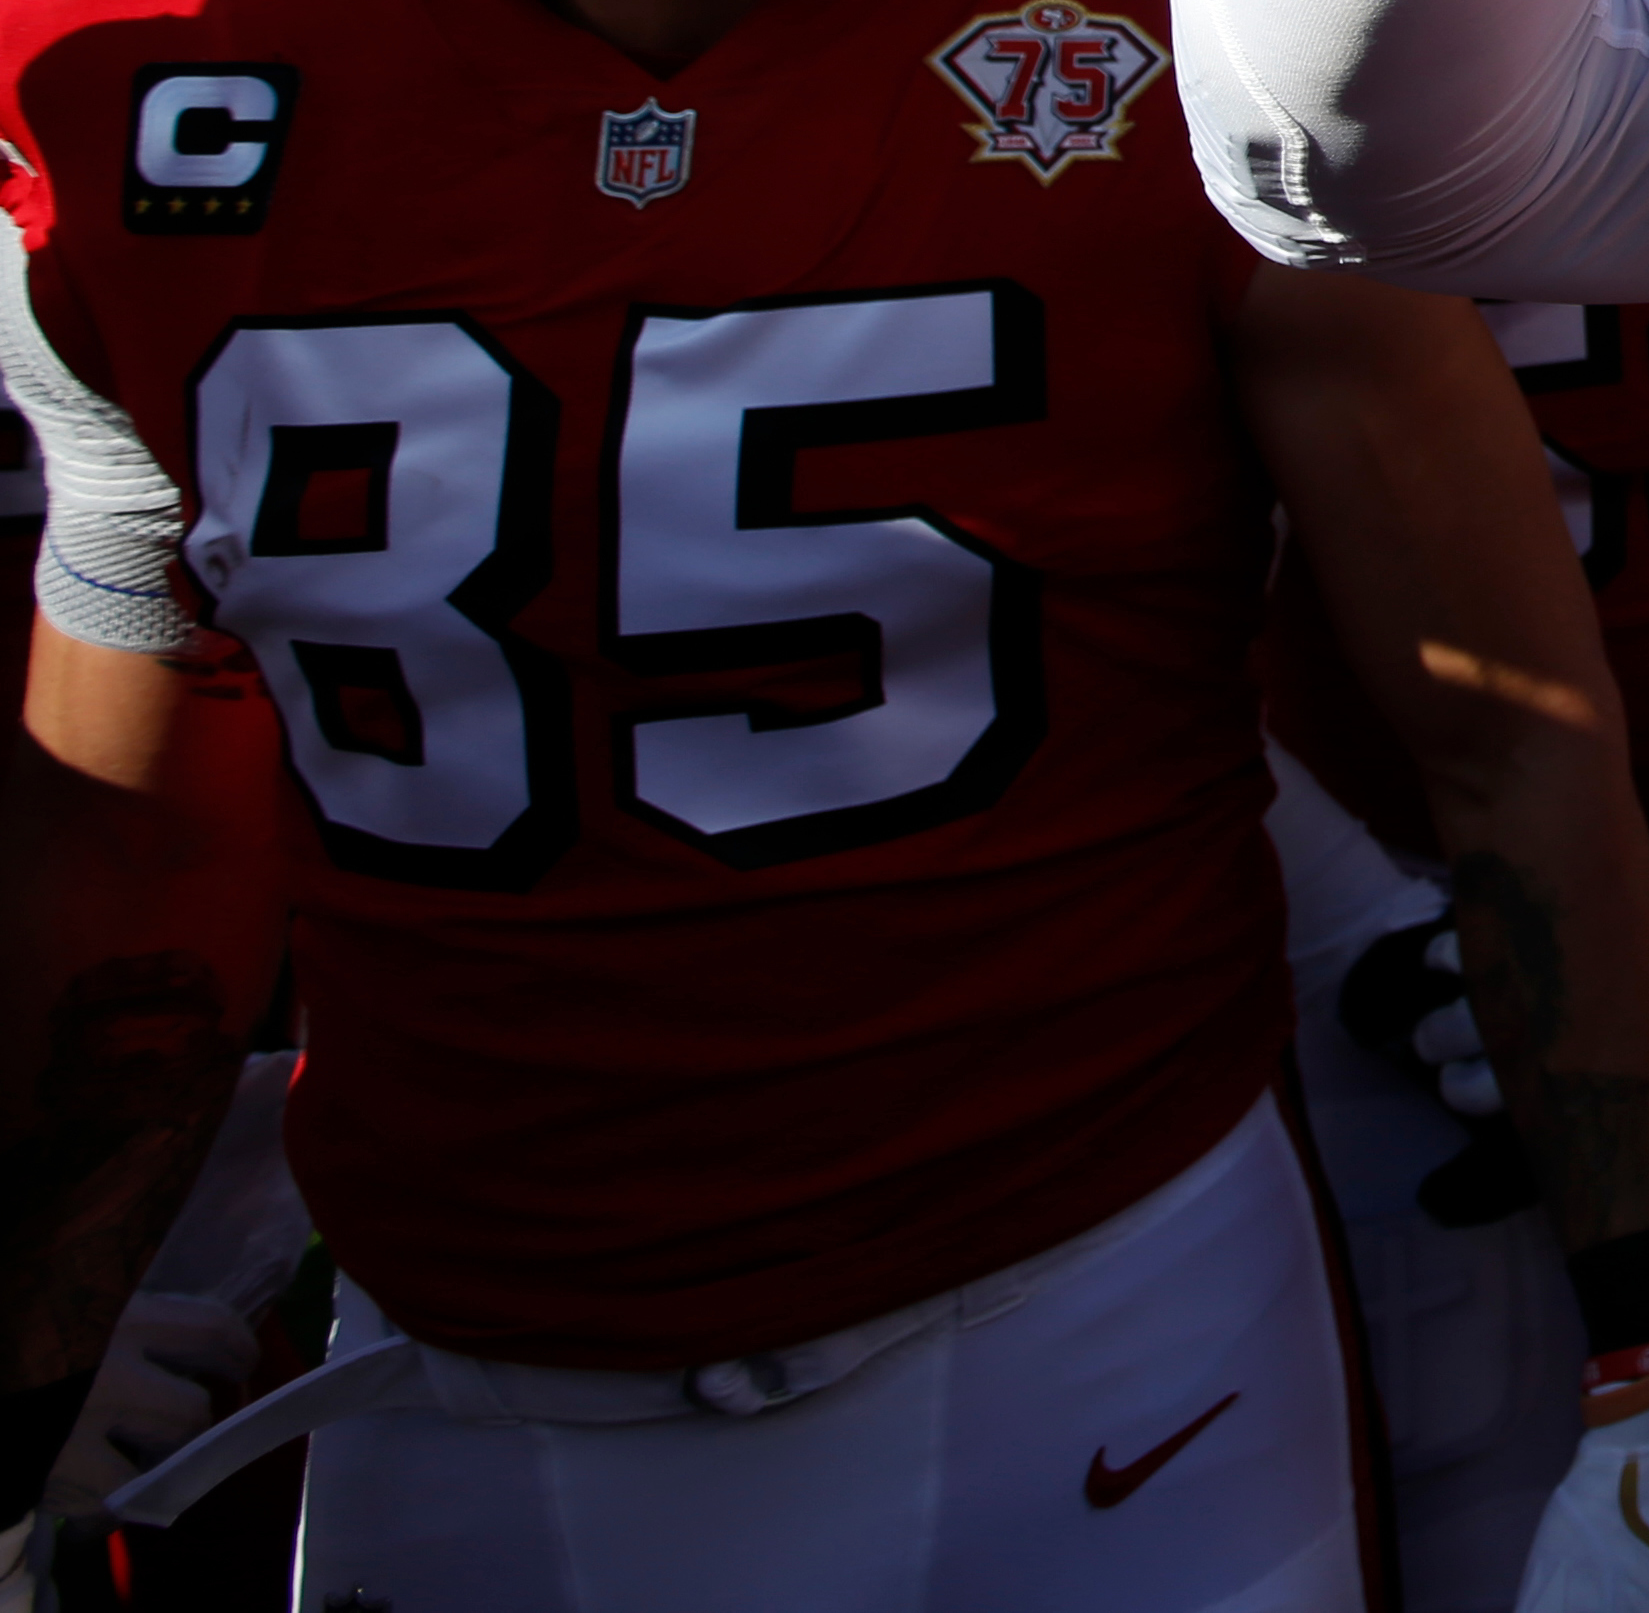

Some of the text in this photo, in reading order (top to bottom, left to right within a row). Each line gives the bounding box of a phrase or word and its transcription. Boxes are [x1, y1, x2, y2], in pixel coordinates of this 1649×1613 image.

[986, 38, 1112, 124] 75
[137, 76, 278, 186] C
[612, 149, 674, 188] NFL
[186, 285, 1015, 862] 85
